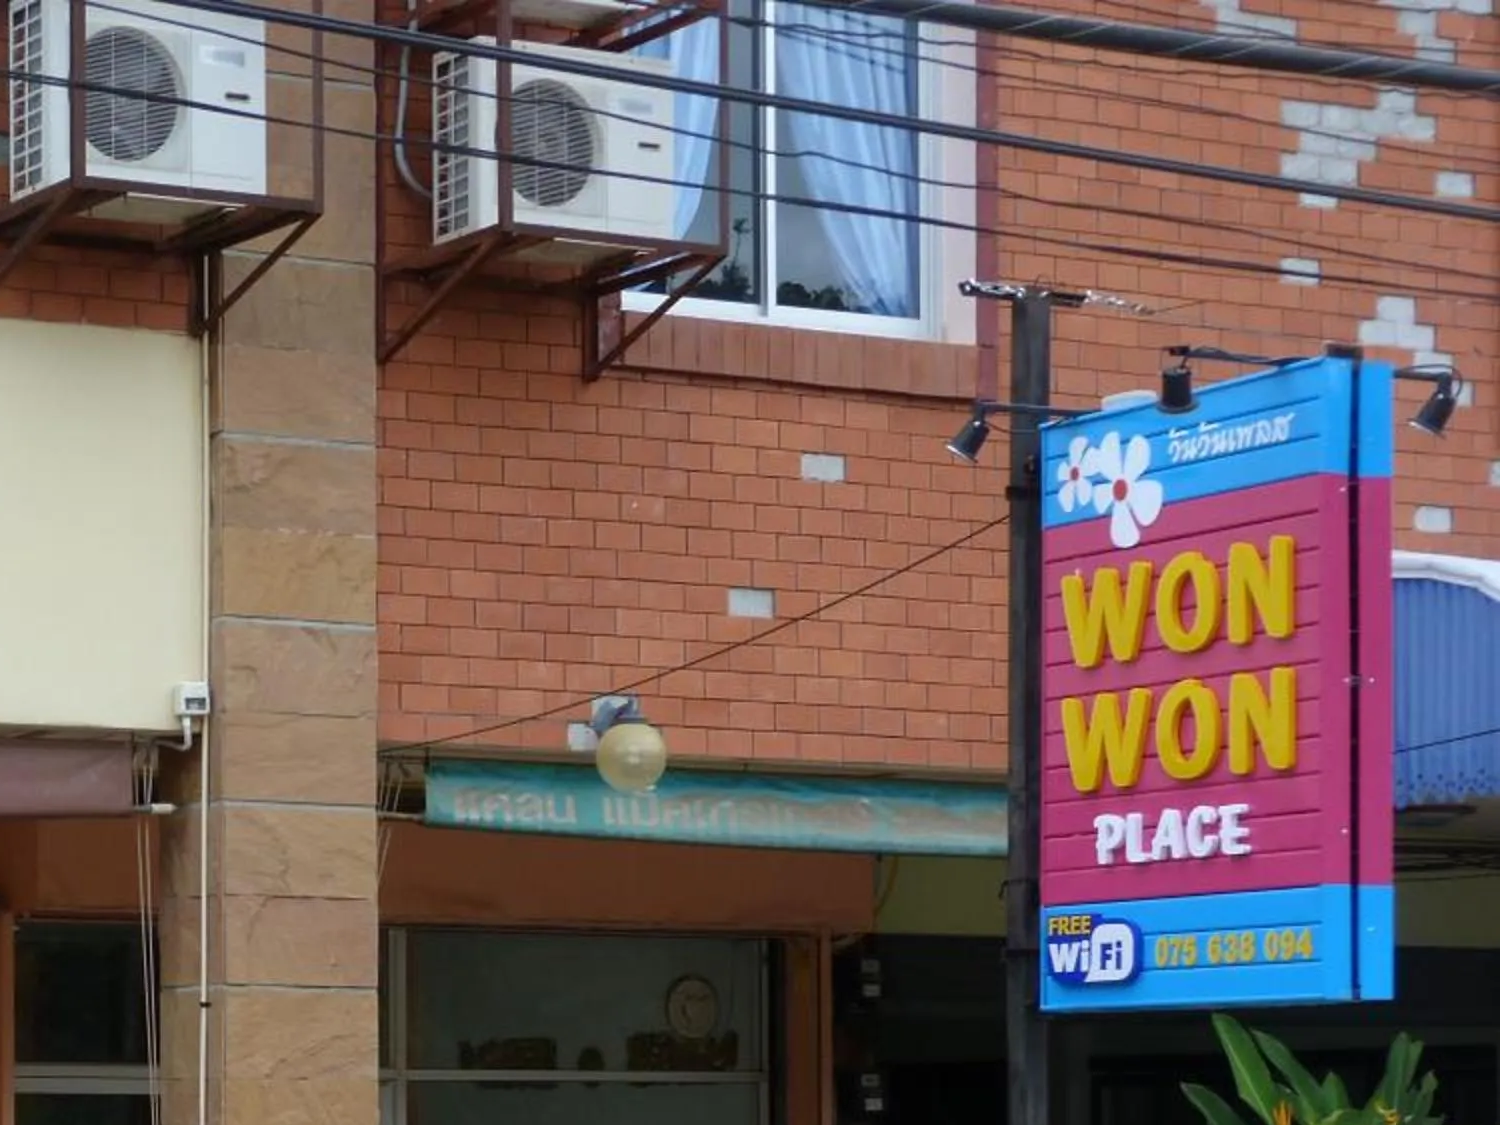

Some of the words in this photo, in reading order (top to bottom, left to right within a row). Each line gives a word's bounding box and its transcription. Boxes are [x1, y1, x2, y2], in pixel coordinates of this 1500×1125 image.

[1060, 535, 1296, 669] WON
[1060, 667, 1297, 793] WON
[1093, 803, 1252, 865] PLACE
[1048, 915, 1091, 936] FREE
[1155, 936, 1197, 968] 075
[1207, 933, 1256, 962] 638
[1264, 929, 1312, 960] 094
